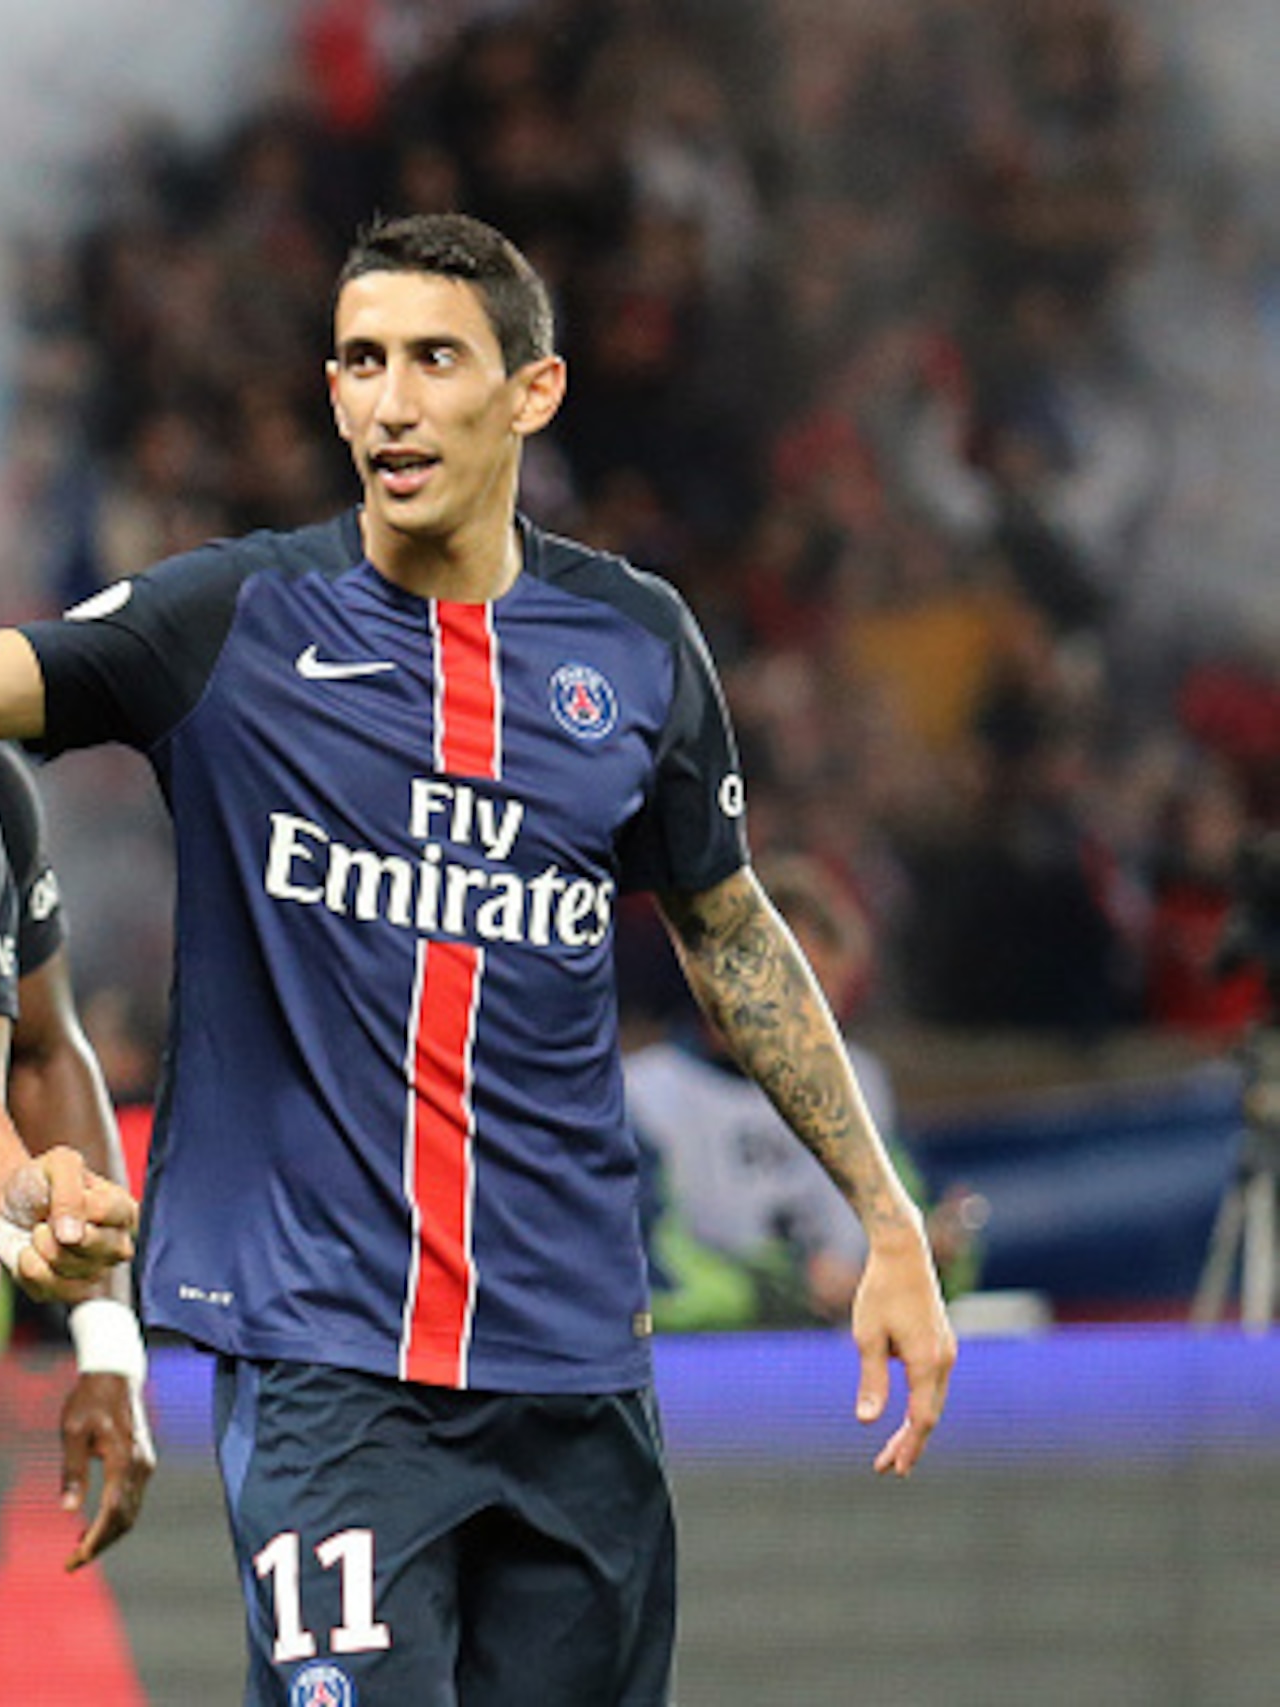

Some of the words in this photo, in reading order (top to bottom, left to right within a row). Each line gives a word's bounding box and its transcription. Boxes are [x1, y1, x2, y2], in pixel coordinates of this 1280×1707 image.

[265, 812, 614, 947] Emirates
[409, 778, 524, 860] Fly
[254, 1529, 391, 1663] 11
